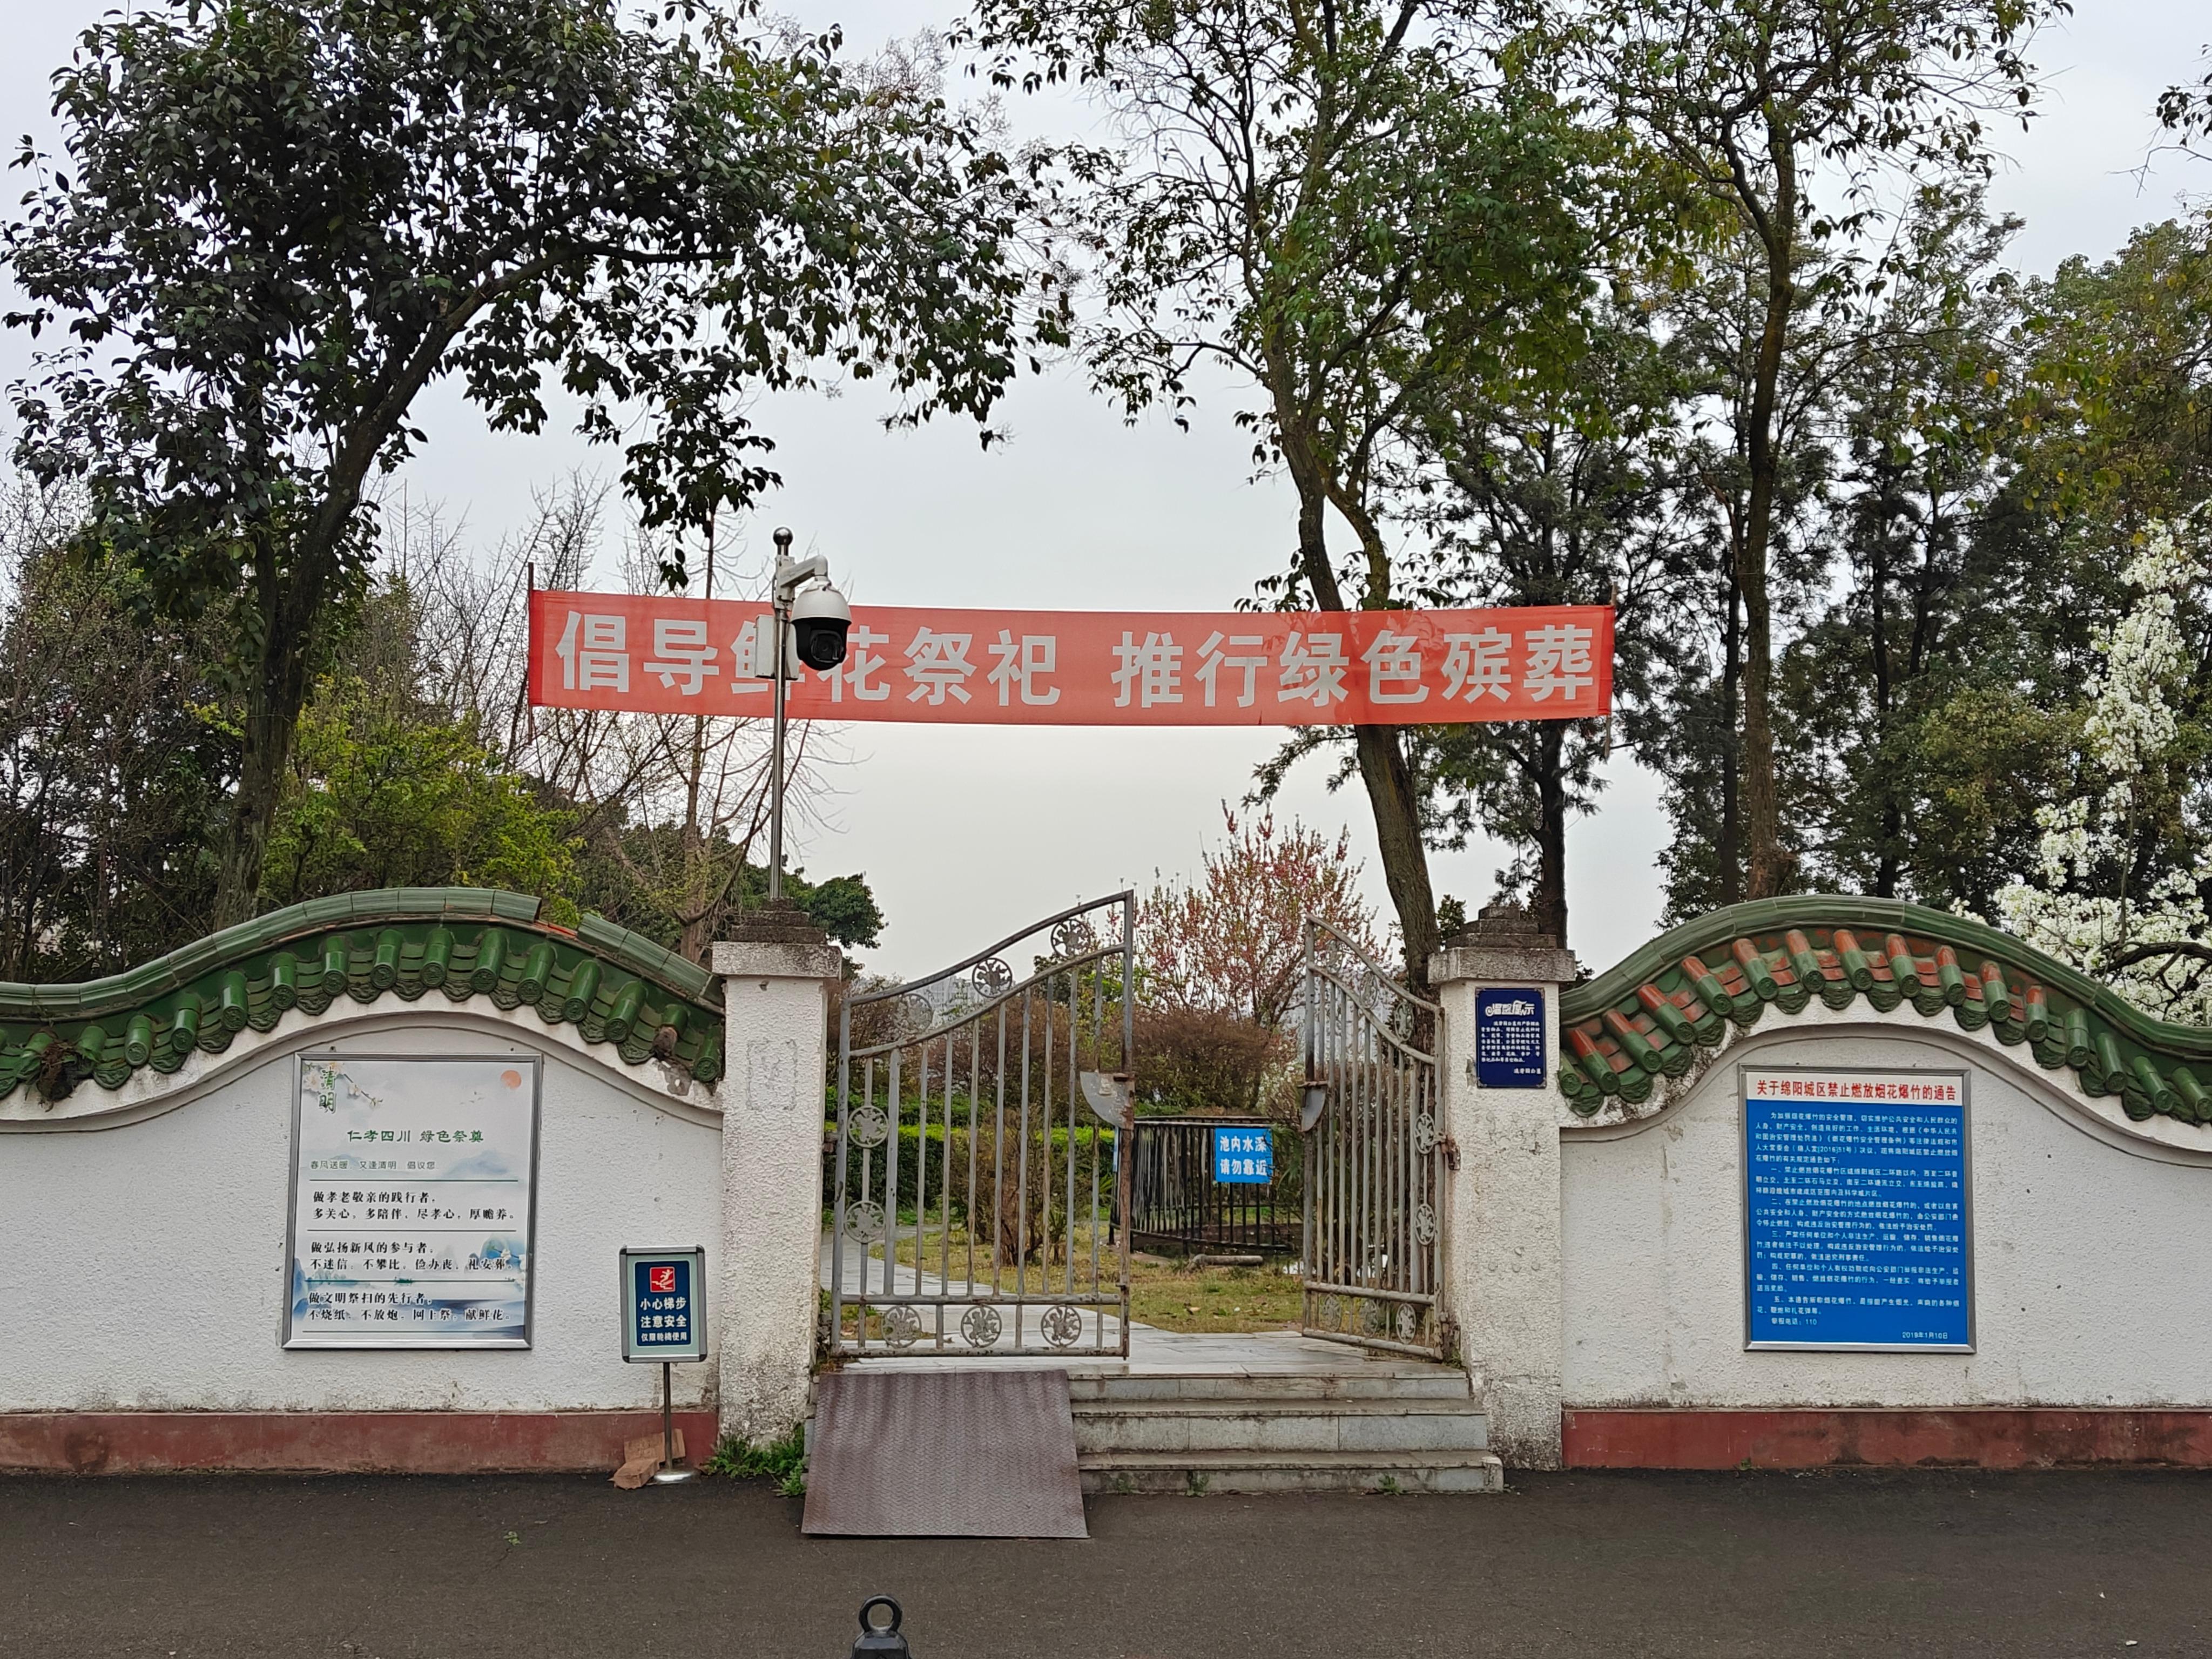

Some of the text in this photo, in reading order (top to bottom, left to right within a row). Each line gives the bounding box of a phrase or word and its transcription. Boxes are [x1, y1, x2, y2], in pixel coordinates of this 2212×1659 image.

[1110, 624, 1594, 709] 推行绿色殡葬
[1757, 1080, 1956, 1101] 关于绵阳城区禁止燃放烟花爆竹的通告
[347, 1129, 484, 1143] 仁孝四川 绿色祭奠
[1220, 1136, 1267, 1152] 池内水深
[1220, 1158, 1267, 1176] 请勿靠近
[640, 1297, 686, 1310] 小心梯步
[640, 1314, 686, 1328] 注意安全
[641, 1332, 687, 1342] 仅限轮椅使用
